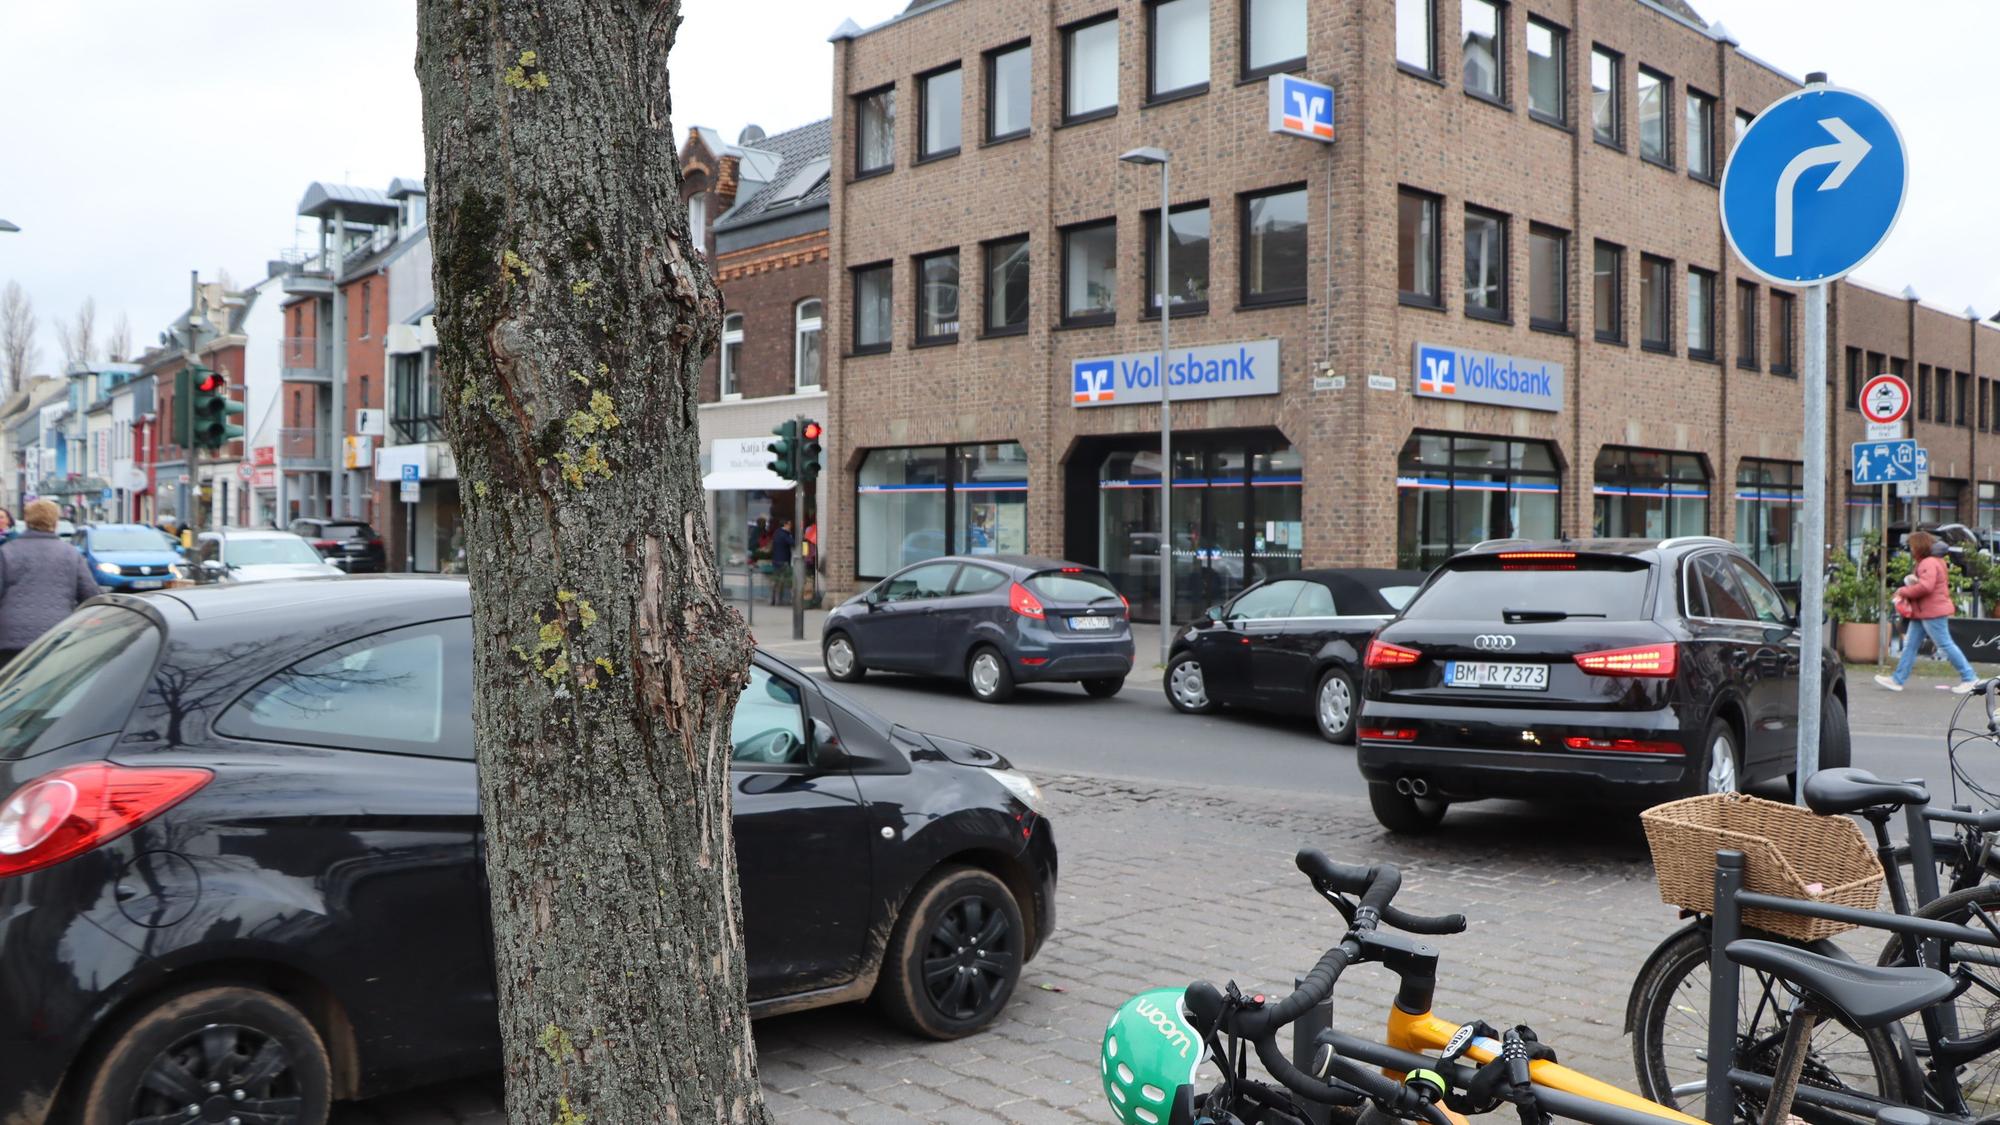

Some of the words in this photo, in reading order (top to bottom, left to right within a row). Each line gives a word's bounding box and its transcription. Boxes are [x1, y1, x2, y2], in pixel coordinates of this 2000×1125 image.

[1460, 355, 1552, 396] Volksbank
[741, 441, 760, 456] Katja
[1455, 664, 1477, 681] BM
[1487, 665, 1498, 682] R
[1503, 666, 1545, 684] 7373
[1135, 998, 1191, 1058] woom
[1446, 1028, 1469, 1053] ABUS
